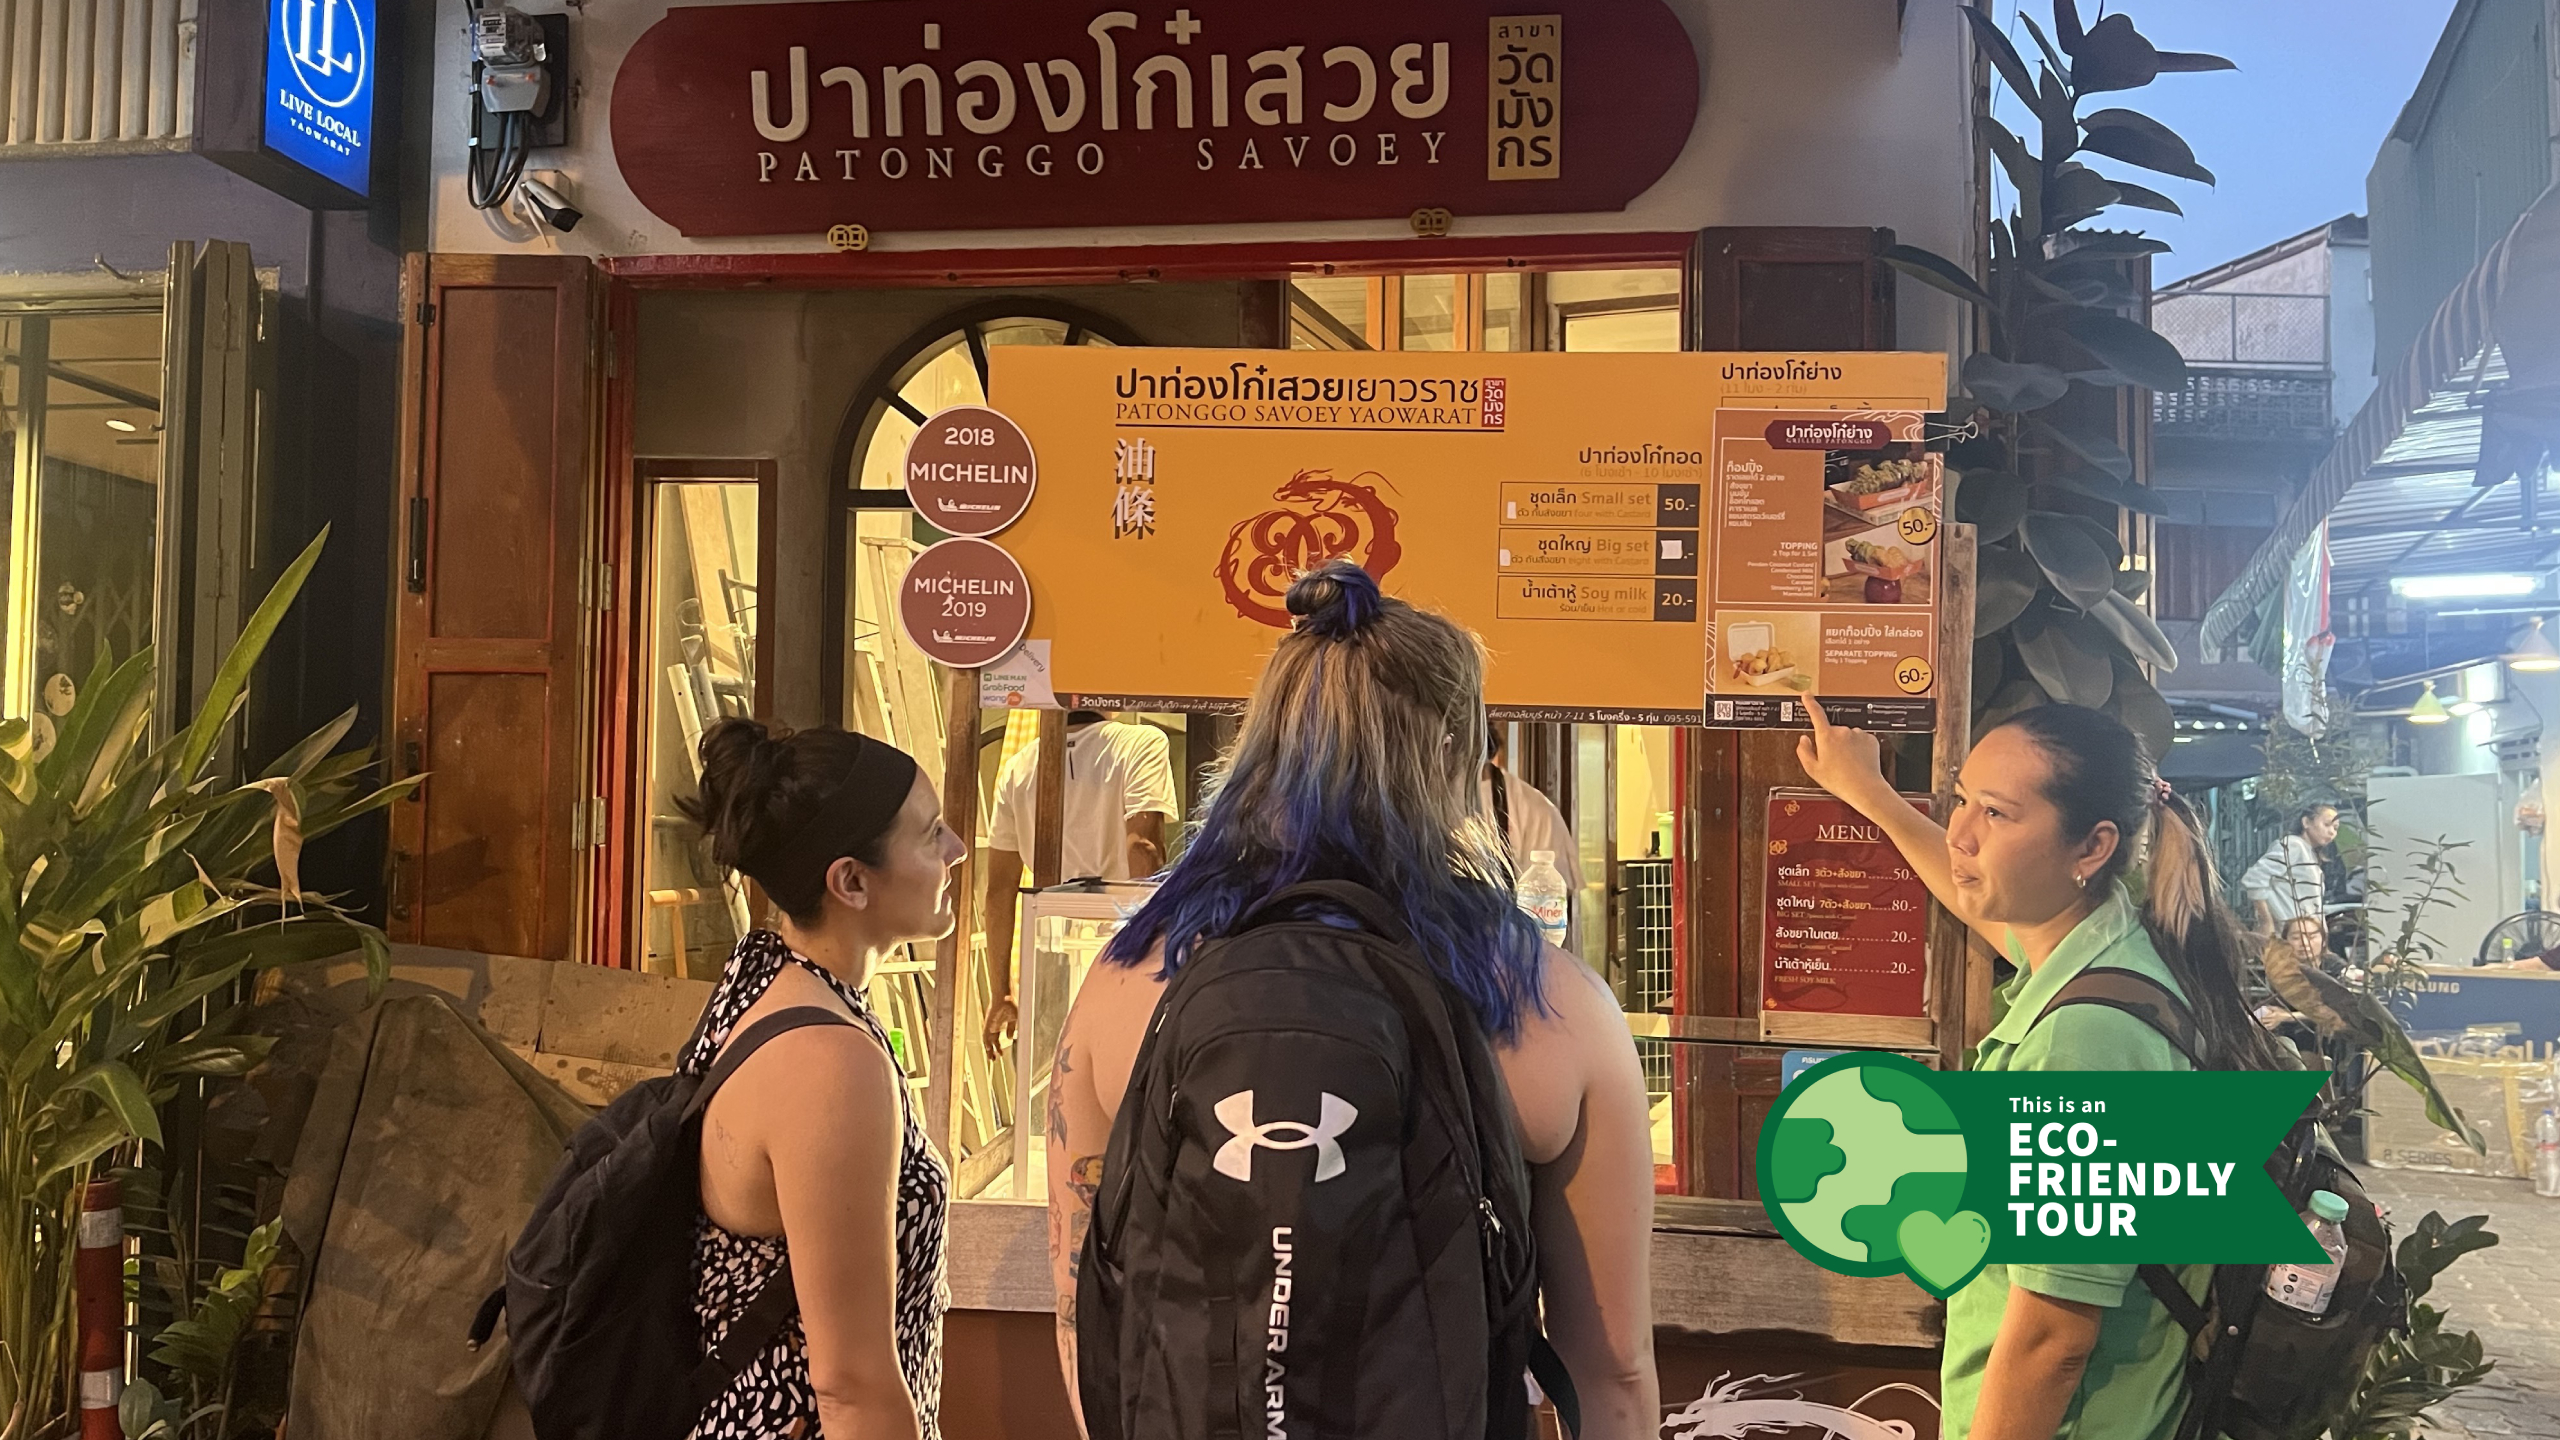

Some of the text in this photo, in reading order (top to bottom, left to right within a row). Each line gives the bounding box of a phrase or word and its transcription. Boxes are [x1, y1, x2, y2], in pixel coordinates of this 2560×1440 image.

[1498, 24, 1555, 38] สาขา
[1498, 44, 1554, 85] วัด
[751, 11, 1450, 142] ปาท่องโก๋เสวย
[280, 88, 361, 147] LIVE LOCAL
[1497, 89, 1554, 129] มัง
[290, 117, 350, 156] YAOWARAT
[757, 132, 1446, 182] PATONGGO SAVOEY
[1497, 135, 1553, 167] กร
[1721, 359, 1842, 380] ปาท่องโก๋ย่าง
[1115, 362, 1479, 403] ปาท่องโก๋เสวยเยาวราช
[1115, 403, 1477, 425] PATONGGO SAVOEY YAOWARAT
[1484, 413, 1503, 425] กร
[944, 427, 995, 446] 2018
[1785, 422, 1873, 439] ปาท่องโก๋ย่าง
[1578, 444, 1702, 465] ปาท่องโก๋ทอด
[911, 463, 1028, 484] MICHELIN
[1112, 437, 1156, 539] 油條
[959, 503, 1001, 511] MICHELIN
[1530, 488, 1696, 511] ชุดเล็ก Small set 50.-
[1902, 518, 1933, 536] 50.-
[1538, 533, 1591, 555] ชุดใหญ่
[1596, 539, 1621, 554] Big
[1626, 541, 1649, 552] set
[1780, 542, 1818, 550] TOPPING
[914, 578, 1014, 595] MICHELIN
[1522, 579, 1694, 606] น้ำเต้าหู้ Soy milk 20.-
[941, 601, 987, 618] 2019
[1019, 643, 1046, 673] Delivery
[1898, 667, 1929, 685] 60.-
[982, 683, 1025, 692] GrabFood
[1081, 696, 1121, 708] วัดมังกร
[1564, 711, 1585, 720] 7-11
[1638, 713, 1644, 721] 5
[1818, 824, 1880, 840] MENU
[1777, 863, 1810, 880] ชุดเล็ก
[1776, 895, 1815, 910] ชุดใหญ่
[2397, 1149, 2453, 1166] SERIES
[1266, 1226, 1292, 1353] UNDER
